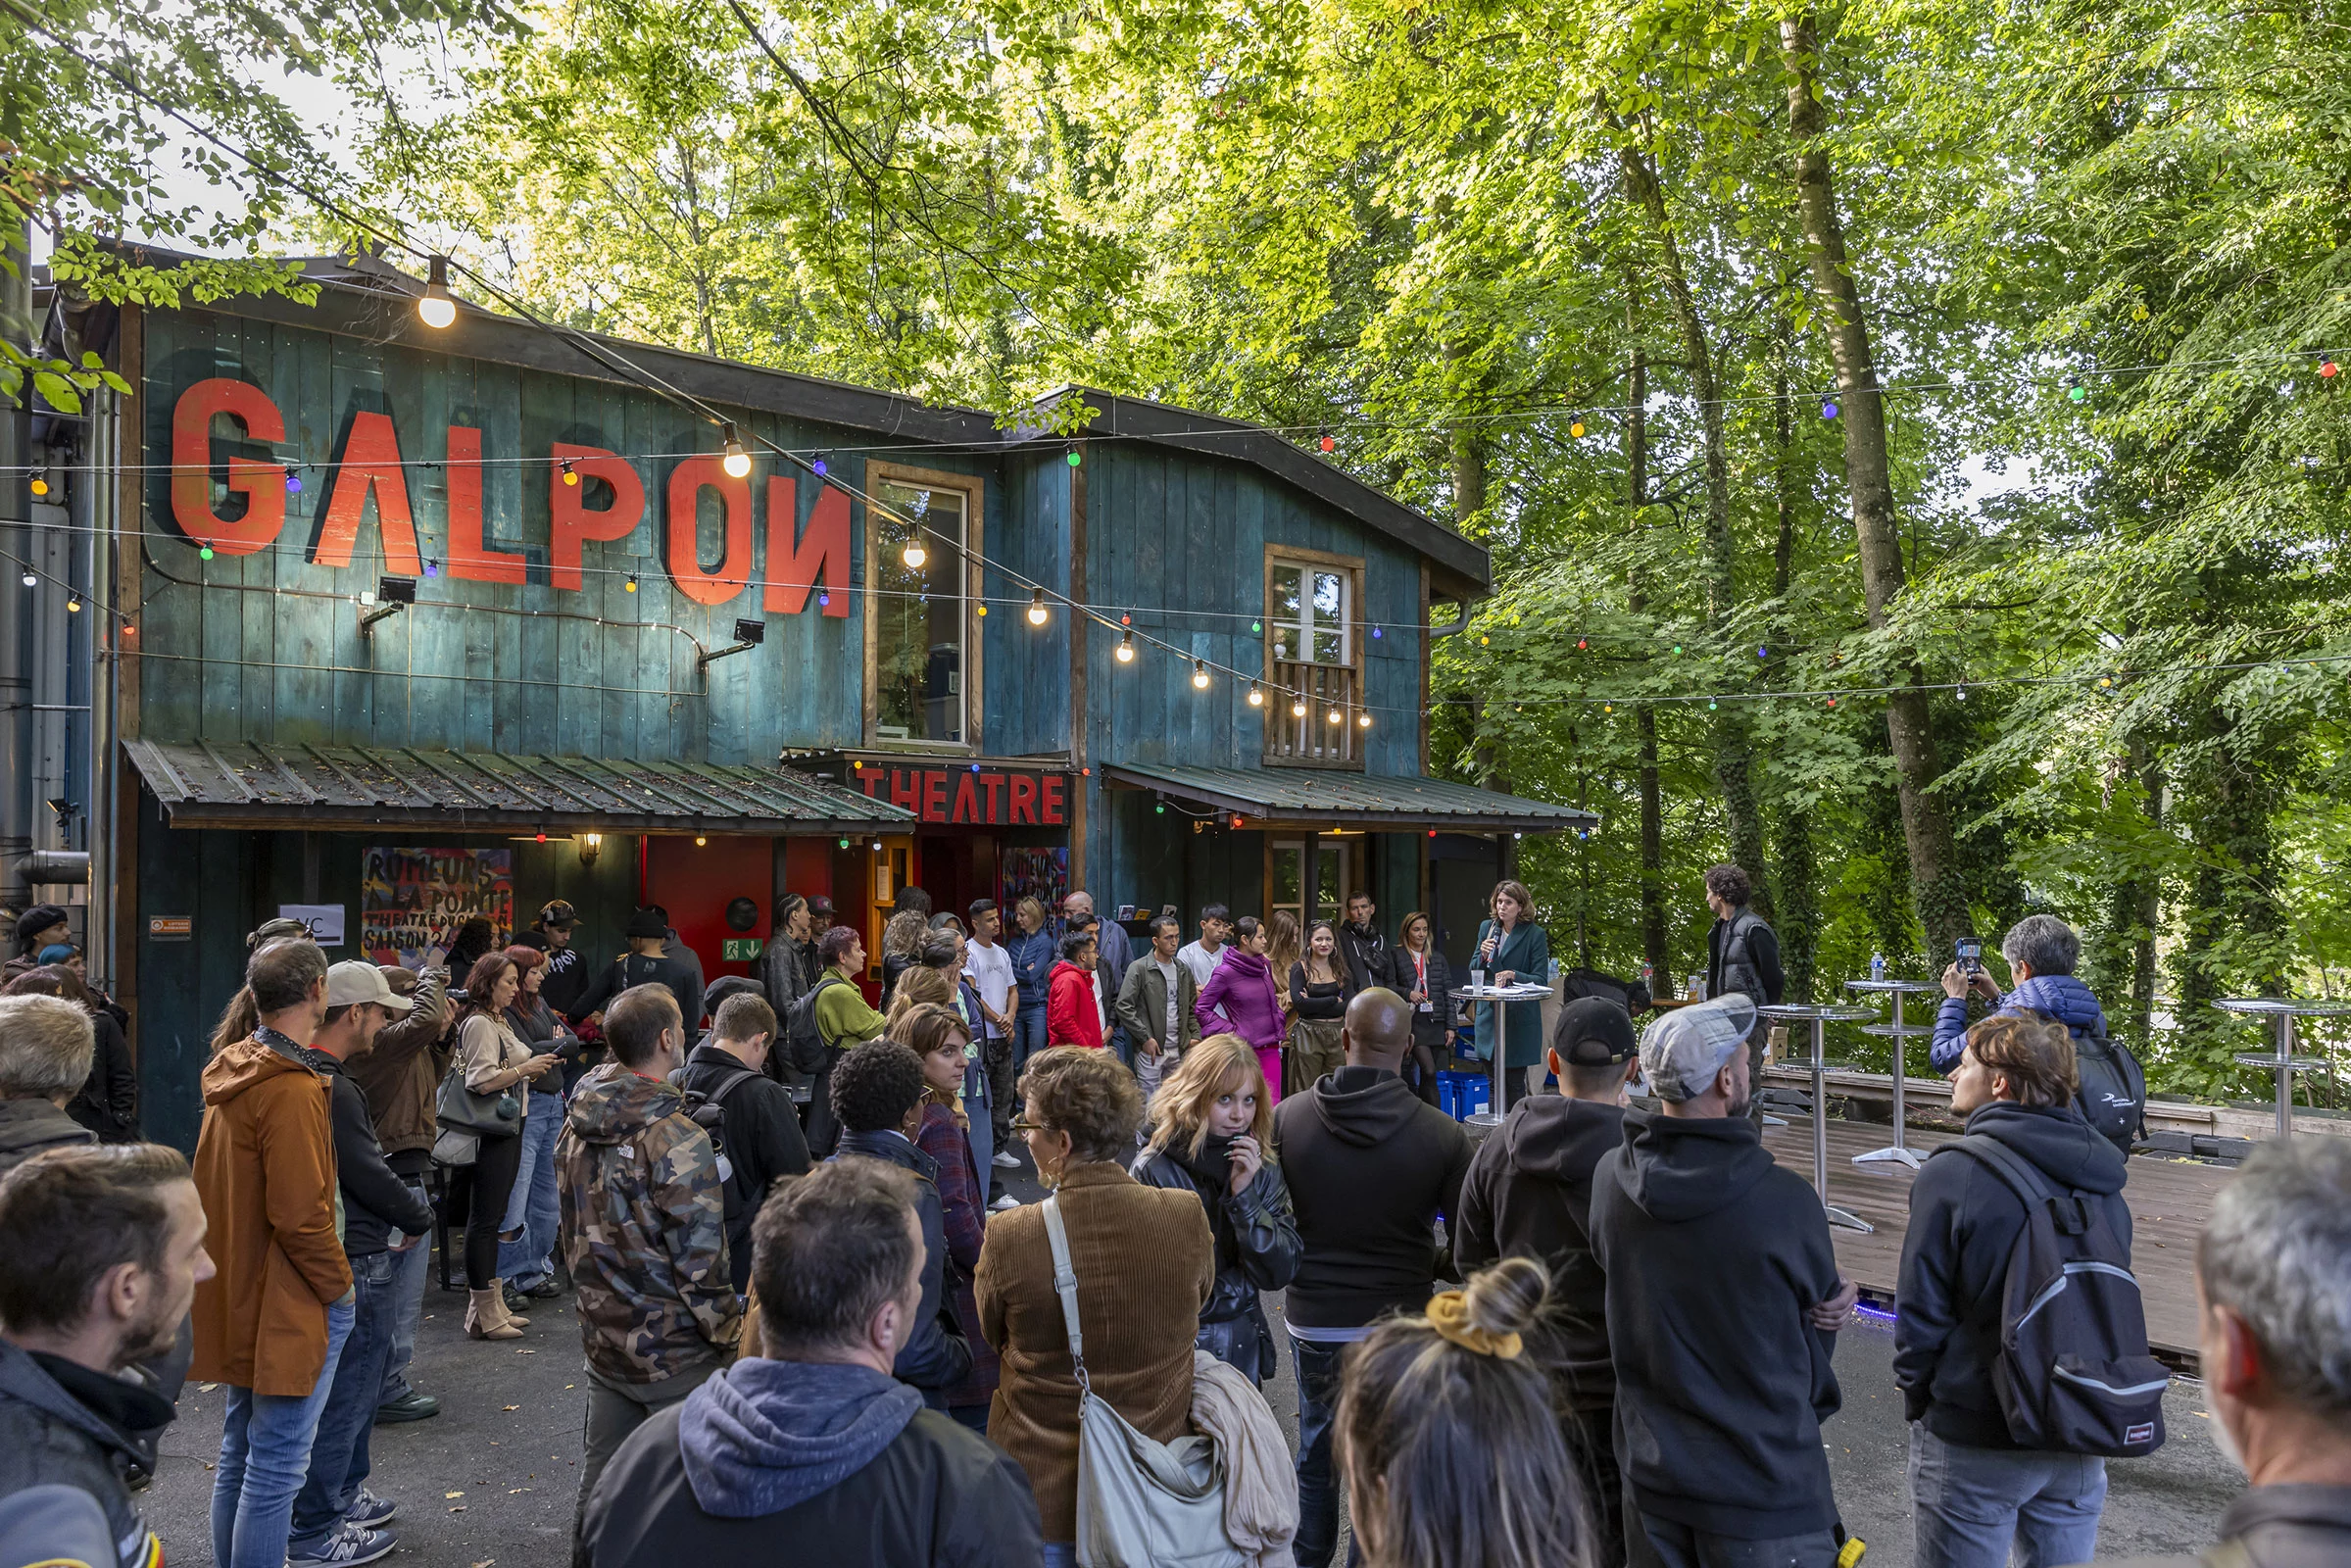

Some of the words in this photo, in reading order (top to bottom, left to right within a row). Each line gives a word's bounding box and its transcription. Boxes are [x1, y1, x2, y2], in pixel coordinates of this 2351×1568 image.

[857, 767, 1063, 824] THEATRE
[368, 854, 491, 888] RUMEURS
[392, 885, 424, 910] LA
[431, 890, 510, 914] POINTE
[367, 913, 436, 927] THEATRE
[440, 915, 455, 927] DU
[365, 929, 427, 951] SAISON
[332, 1542, 359, 1561] N
